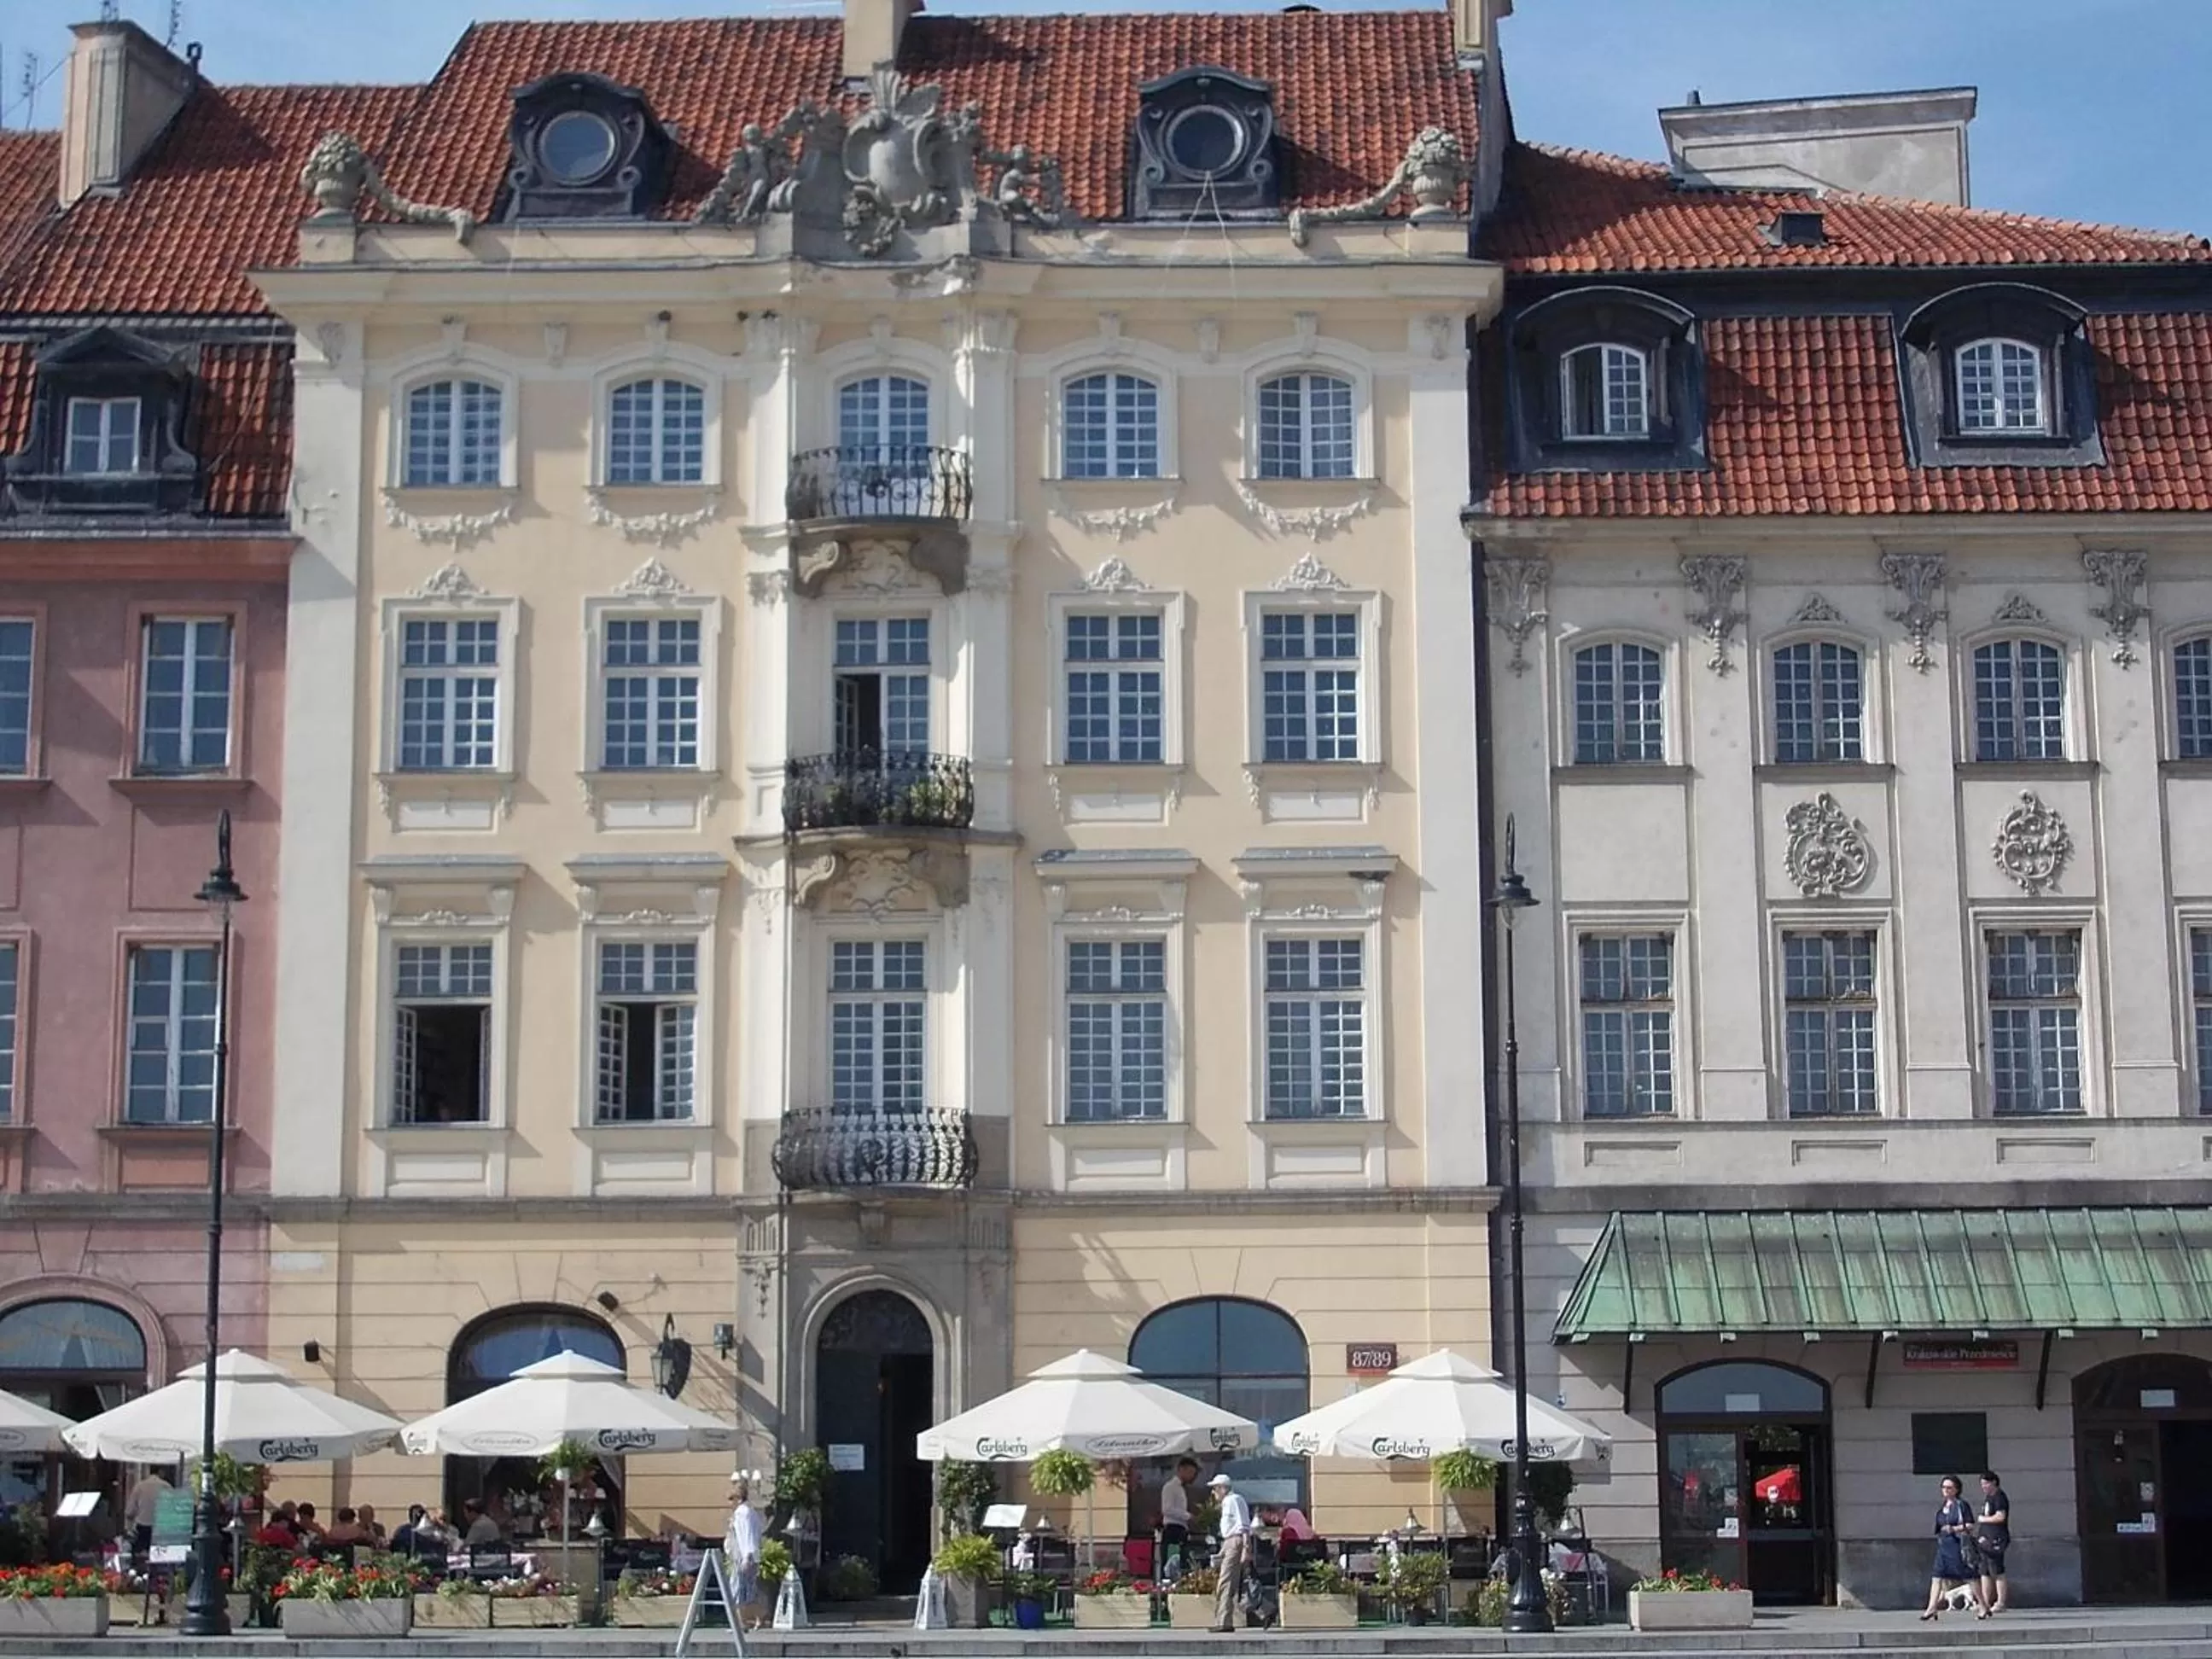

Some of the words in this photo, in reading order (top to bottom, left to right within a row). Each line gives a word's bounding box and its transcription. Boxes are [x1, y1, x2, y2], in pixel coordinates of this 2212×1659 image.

[1352, 1350, 1392, 1367] 87/89
[259, 1438, 318, 1462] Carlsberg
[599, 1429, 656, 1451] Carlsberg
[976, 1437, 1027, 1460] Carlsberg
[1210, 1428, 1241, 1451] Carlsberg
[1291, 1432, 1320, 1454] Carlsberg
[1372, 1437, 1430, 1460] Carlsberg
[1501, 1439, 1556, 1459] Caberg
